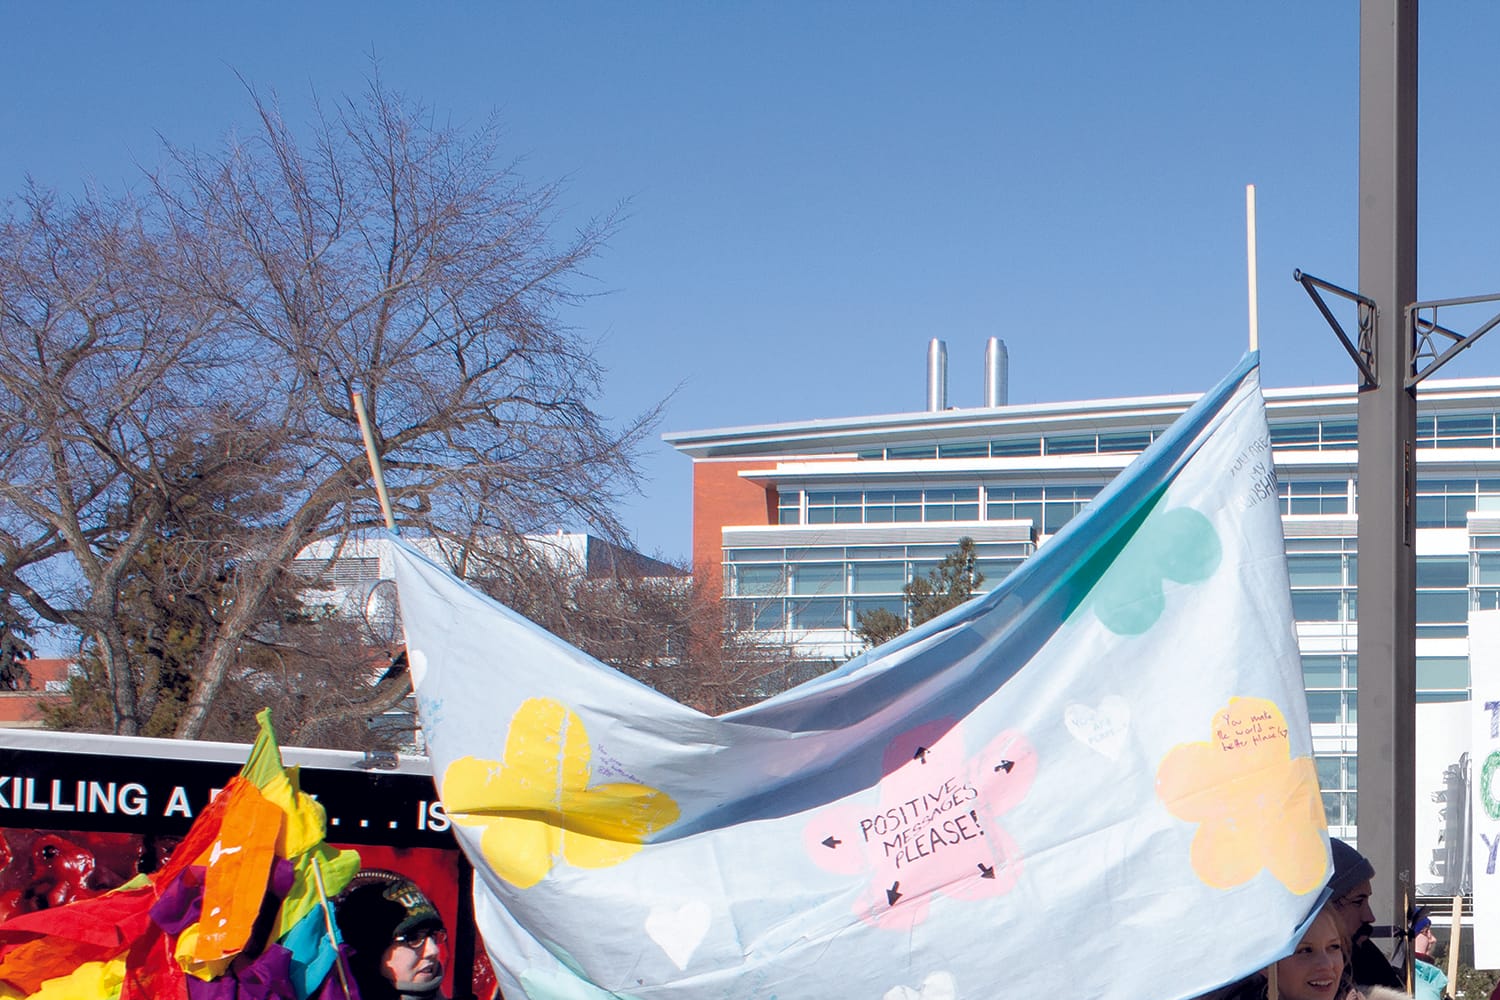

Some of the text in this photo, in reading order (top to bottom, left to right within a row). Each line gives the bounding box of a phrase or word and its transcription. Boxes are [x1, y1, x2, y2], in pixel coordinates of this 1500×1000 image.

[163, 786, 193, 819] A
[416, 799, 450, 832] IS
[859, 776, 963, 842] POSITIVE
[882, 783, 979, 857] MESSAGES
[895, 809, 986, 869] PLEASE!
